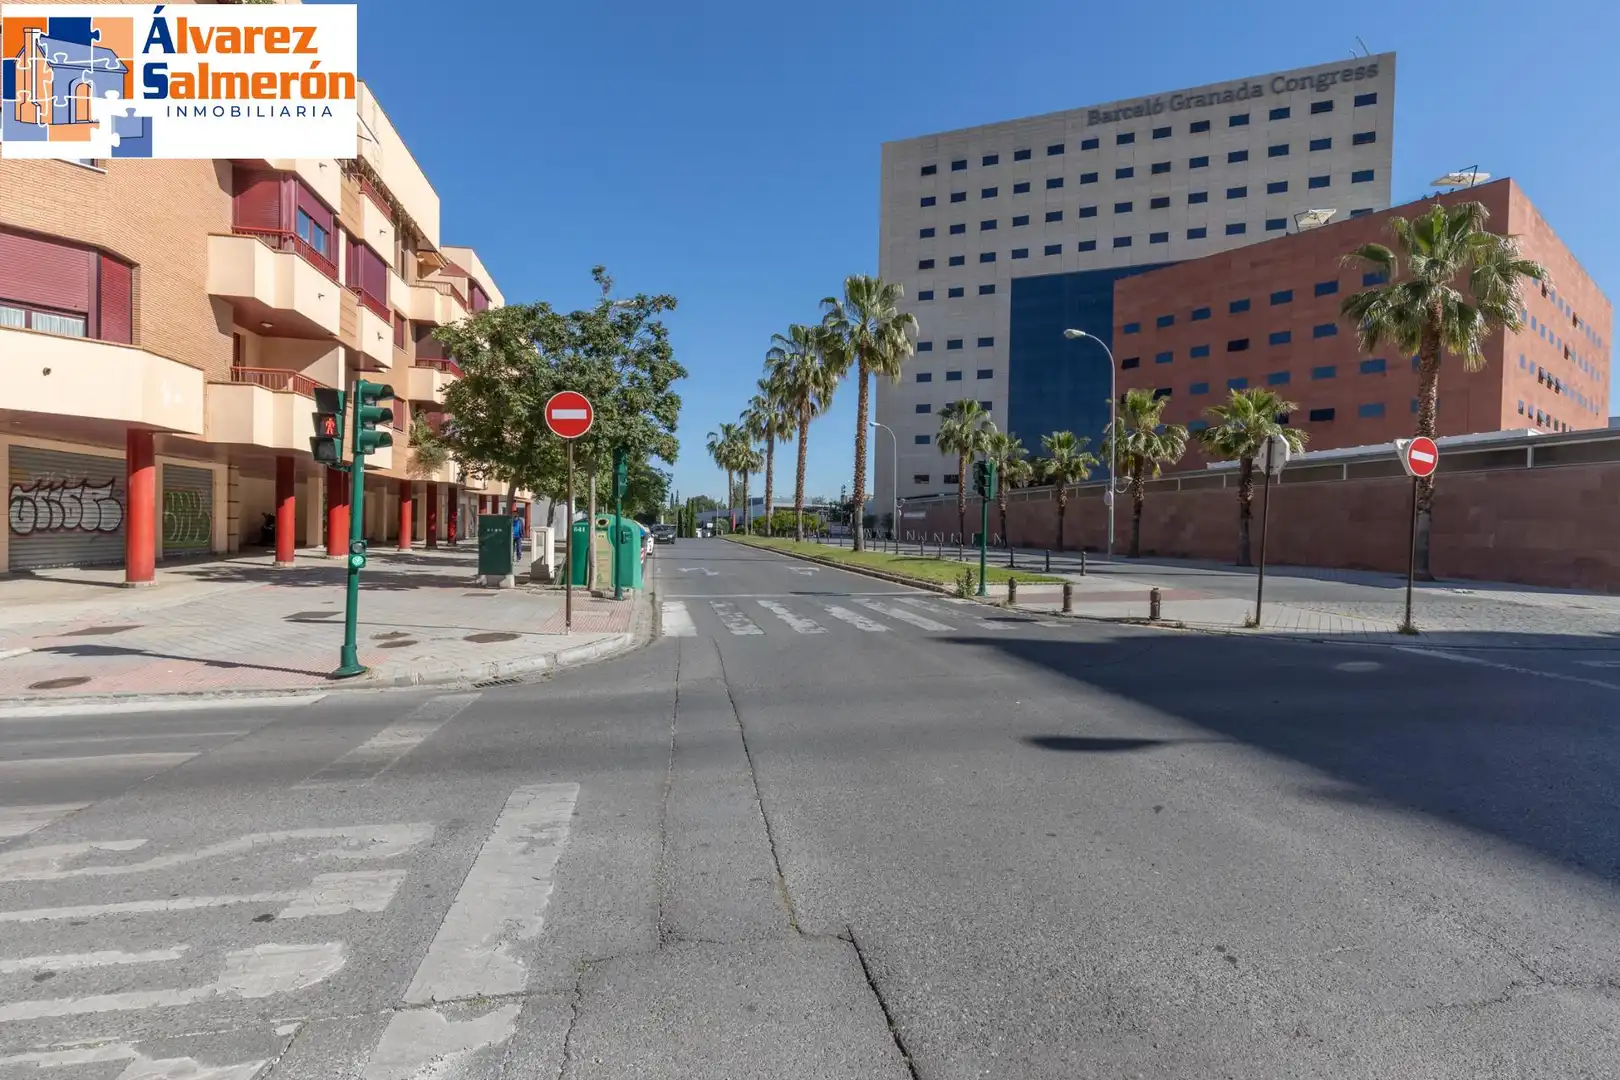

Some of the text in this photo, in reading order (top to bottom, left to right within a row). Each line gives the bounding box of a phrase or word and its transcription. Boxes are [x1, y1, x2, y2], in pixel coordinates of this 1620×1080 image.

[1086, 62, 1379, 126] Barceló Granada Congress
